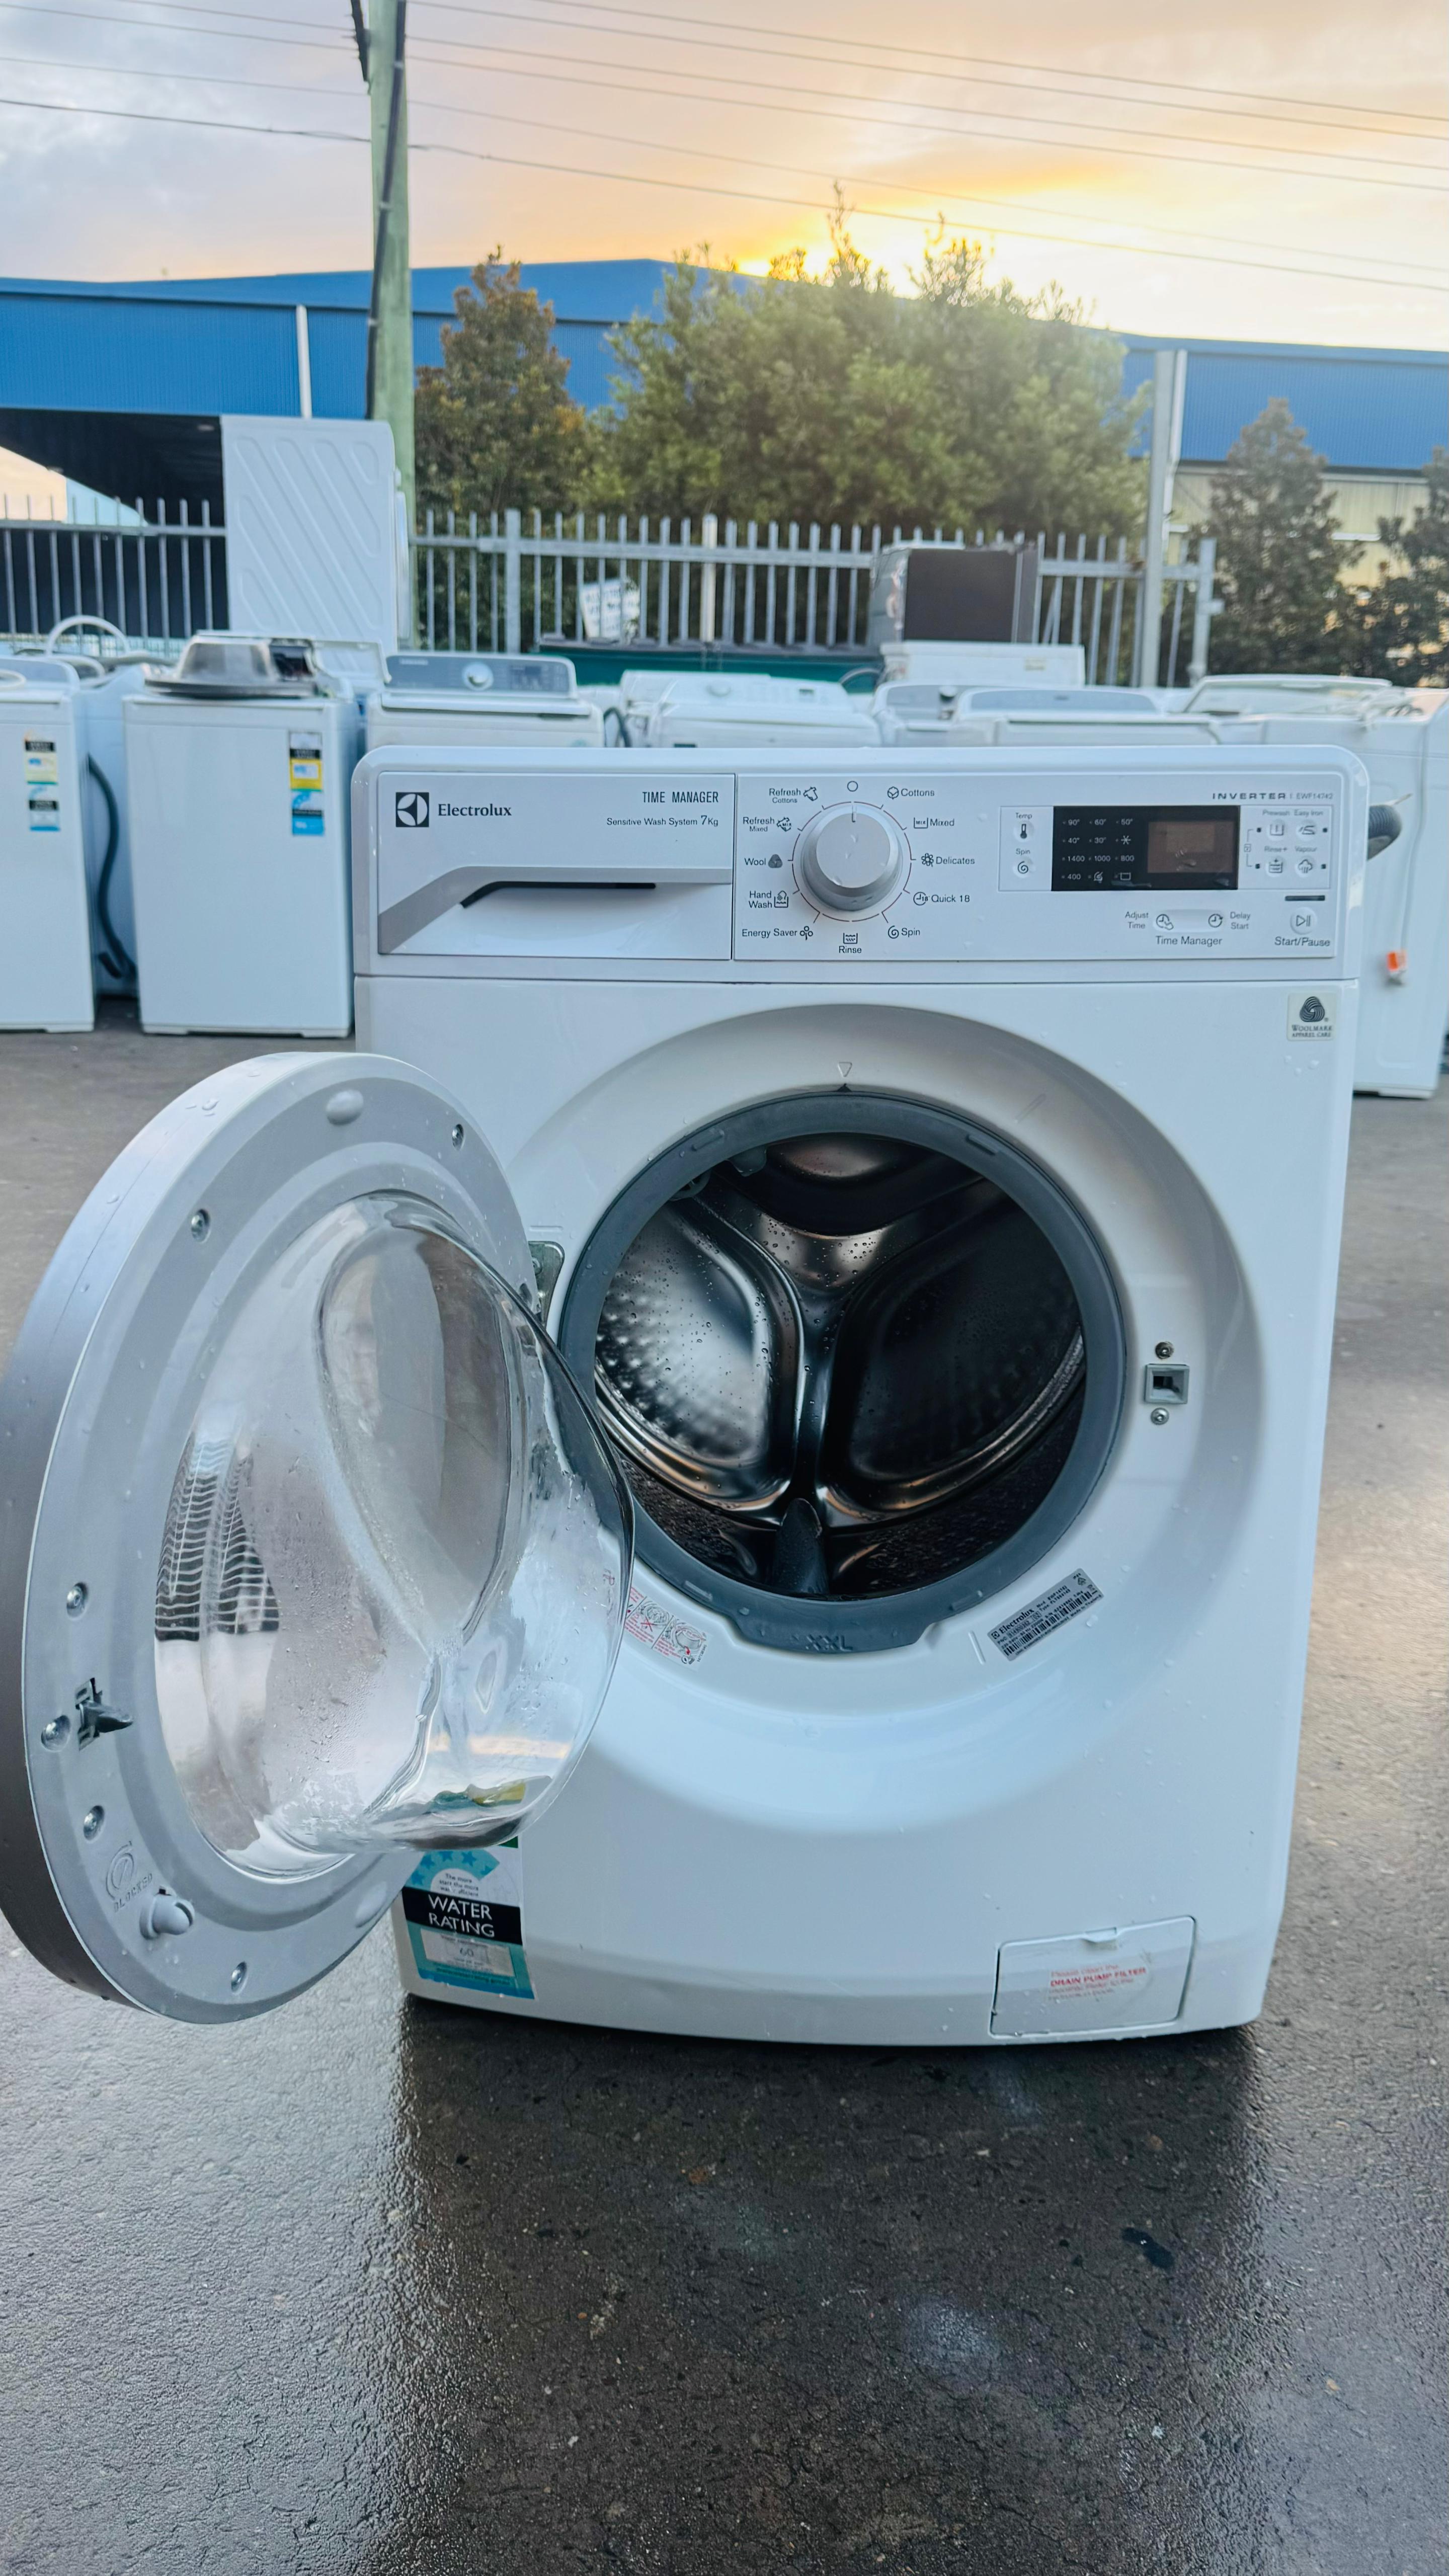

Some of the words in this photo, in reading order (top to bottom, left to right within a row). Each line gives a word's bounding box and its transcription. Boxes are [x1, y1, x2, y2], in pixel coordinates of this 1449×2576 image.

[642, 791, 666, 803] TIME
[672, 791, 718, 803] MANAGER
[769, 788, 801, 796] Refresh
[901, 788, 935, 797] Cottons
[438, 802, 512, 817] Electrolux
[606, 817, 641, 826] Sensitive
[643, 818, 667, 826] Wash
[669, 818, 698, 827] System
[743, 817, 775, 825] Refresh
[930, 818, 954, 826] Mixed
[744, 858, 766, 866] Wool
[936, 856, 976, 865] Delicates
[749, 890, 772, 899] Hand
[931, 894, 956, 903] Quick
[959, 895, 970, 903] 18
[749, 900, 773, 909] Wash
[1124, 911, 1149, 920] Adjust
[1230, 911, 1251, 921] Delay
[1230, 922, 1249, 930] Start
[742, 929, 771, 939] Energy
[773, 928, 797, 937] Saver
[901, 928, 921, 938] Spin
[1155, 935, 1178, 945] Time
[1181, 936, 1223, 947] Manager
[1274, 936, 1331, 947] Start/Pause
[838, 945, 862, 954] Rinse
[999, 1608, 1034, 1634] Electrolux
[806, 1634, 853, 1652] XXL
[428, 1894, 492, 1920] WATER
[429, 1912, 495, 1937] RATING
[1051, 1977, 1081, 1987] DRAIN
[1084, 1973, 1112, 1982] PUMP
[1114, 1967, 1147, 1978] FILTER
